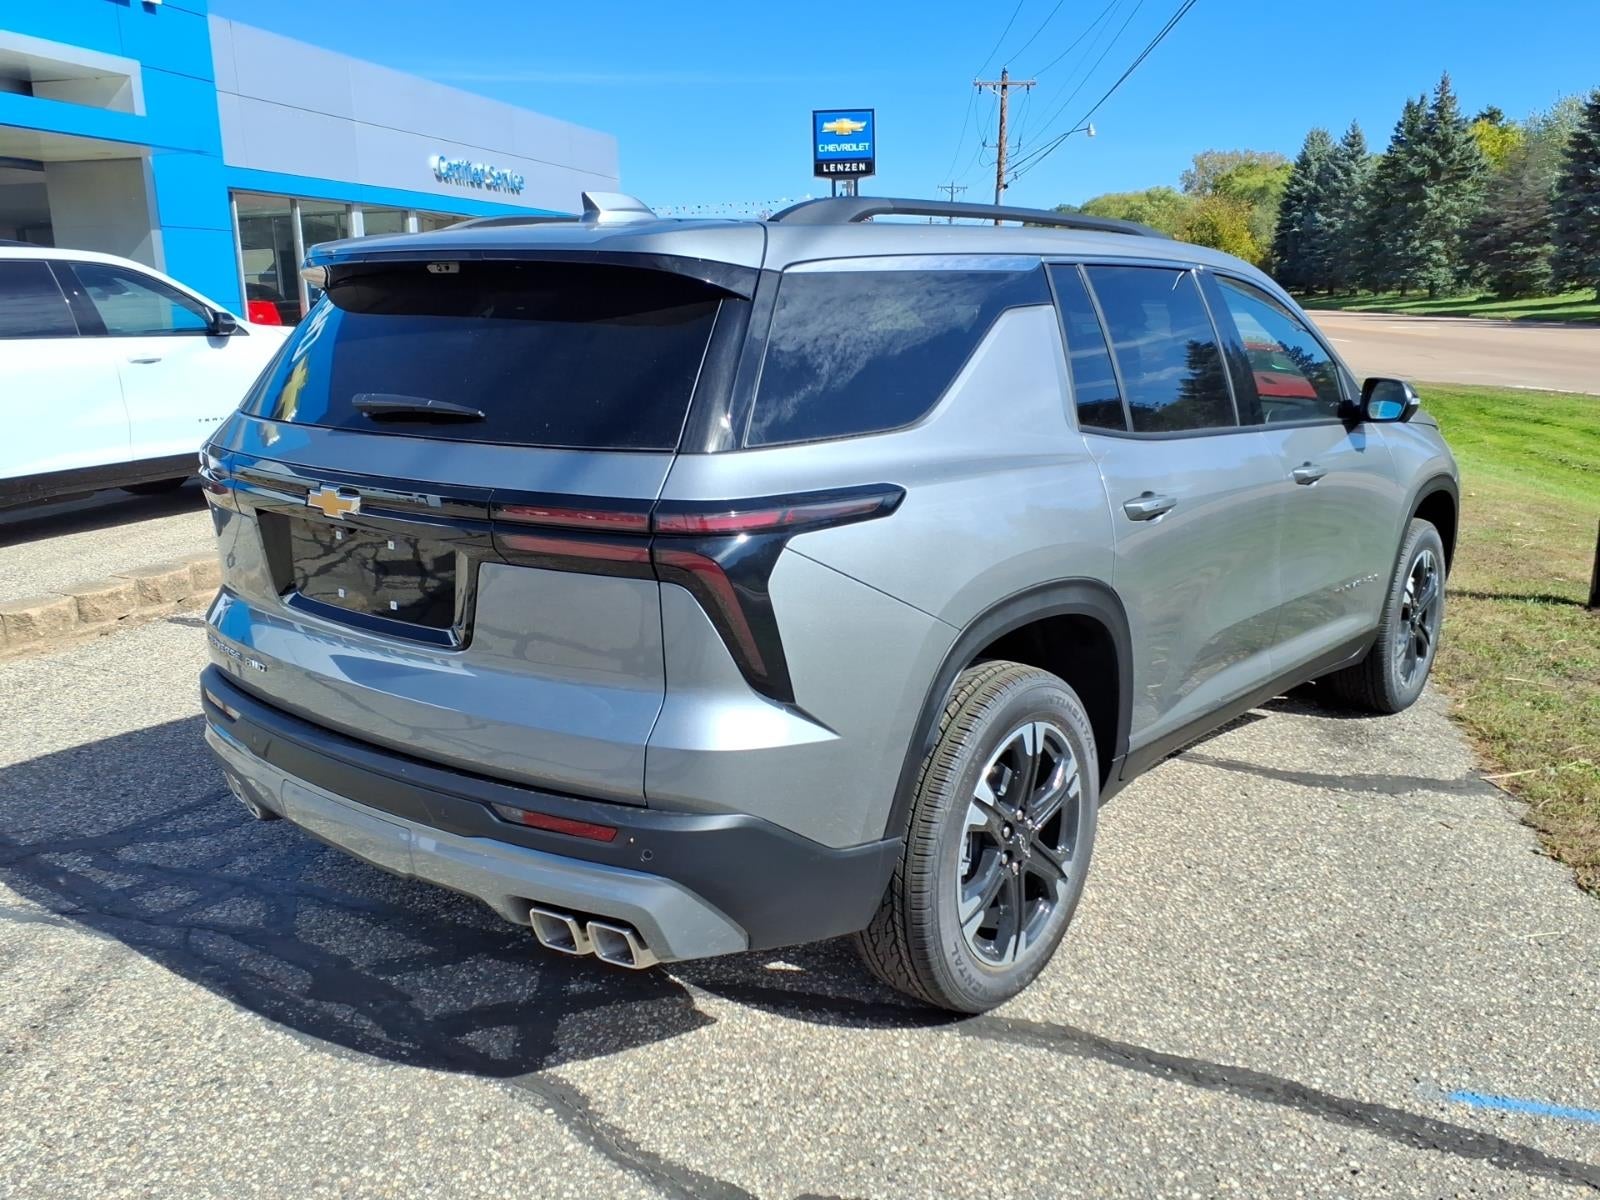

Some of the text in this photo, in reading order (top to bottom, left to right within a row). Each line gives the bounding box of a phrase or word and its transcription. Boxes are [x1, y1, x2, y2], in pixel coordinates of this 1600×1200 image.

[818, 142, 870, 153] CHEVROLET
[436, 154, 525, 191] Certified Service
[823, 162, 866, 172] LENZEN
